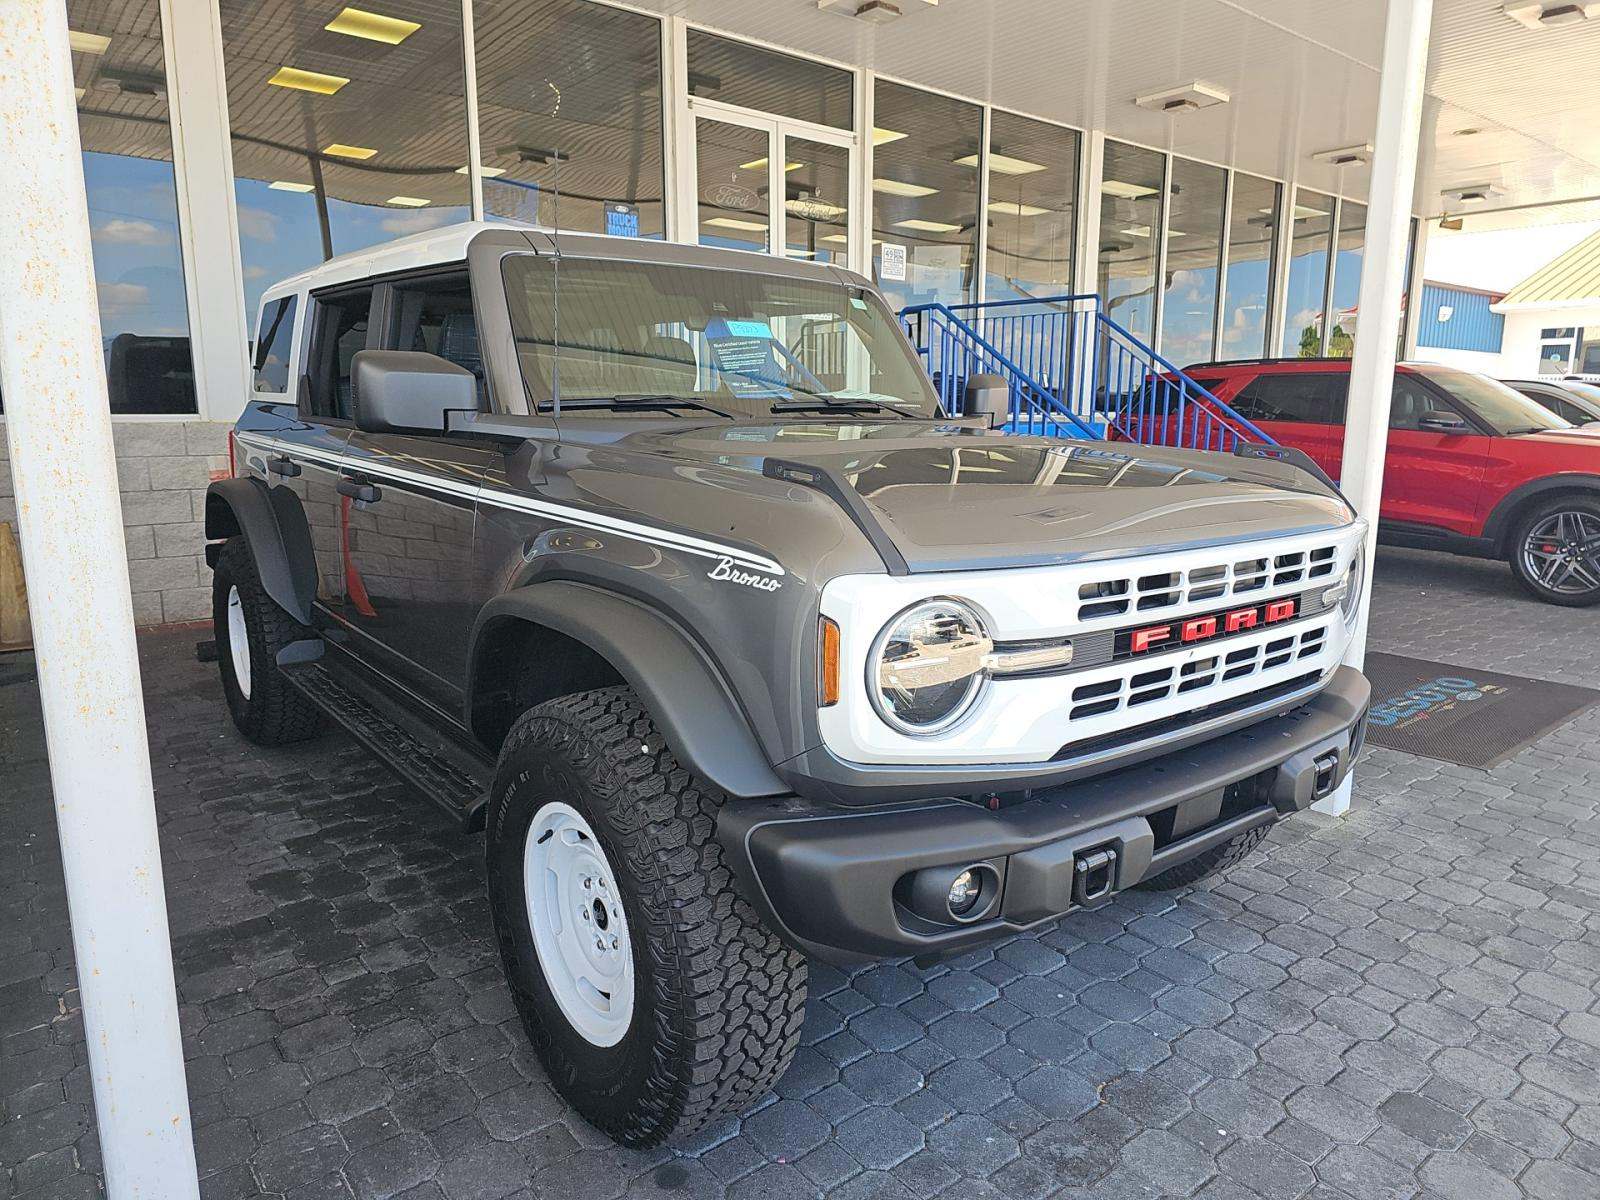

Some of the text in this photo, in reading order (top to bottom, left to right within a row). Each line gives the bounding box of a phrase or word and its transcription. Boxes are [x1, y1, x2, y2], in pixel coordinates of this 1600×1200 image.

[716, 186, 753, 207] Ford
[607, 211, 637, 227] TRUCK
[608, 224, 637, 238] MONTH
[707, 555, 782, 592] Bronco
[1131, 600, 1295, 653] FORD
